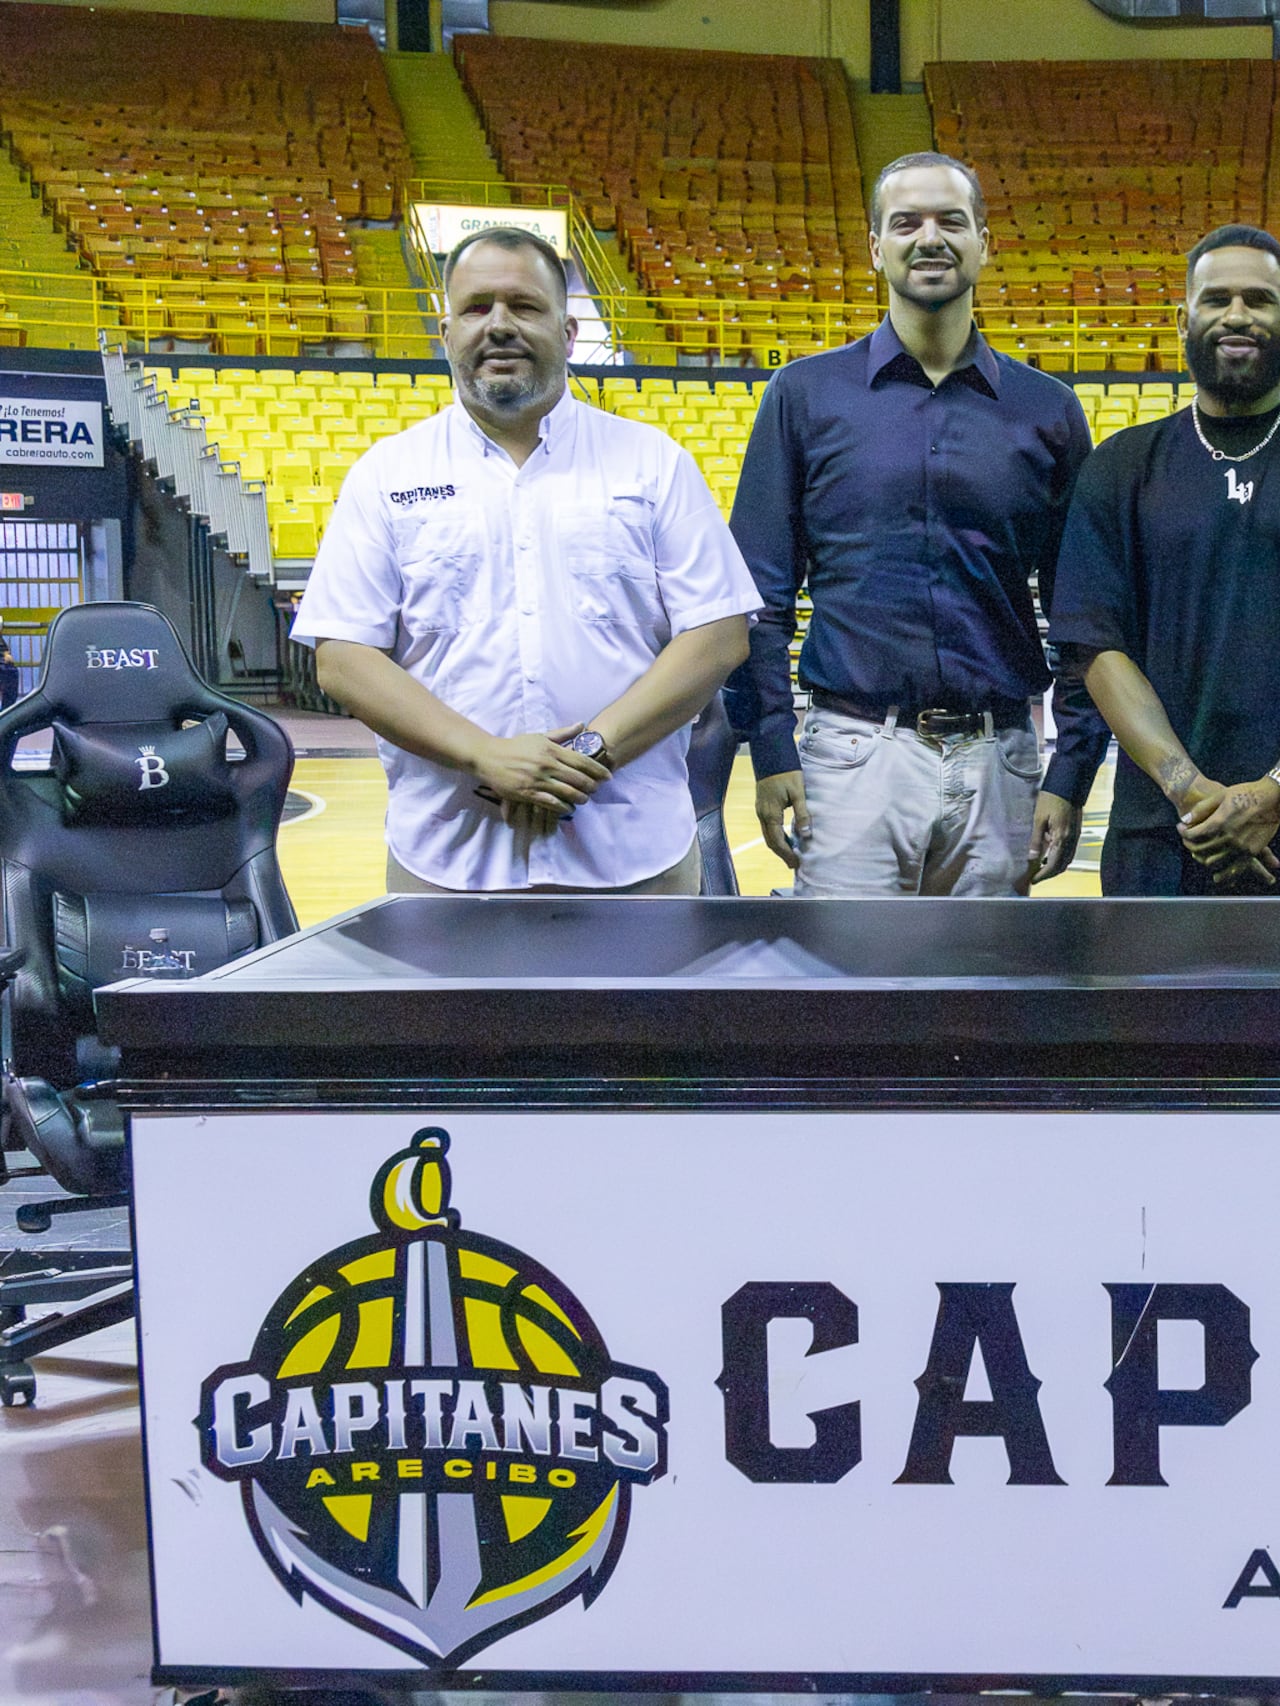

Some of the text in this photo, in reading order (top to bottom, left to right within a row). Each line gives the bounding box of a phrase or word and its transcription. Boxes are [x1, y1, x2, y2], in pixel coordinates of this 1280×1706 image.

[768, 350, 781, 366] B
[21, 405, 65, 417] Tenemos!
[6, 447, 94, 460] cabreraauto.com
[390, 485, 456, 503] CAPITANES
[85, 648, 160, 671] BEAST
[134, 756, 170, 791] B
[209, 1372, 660, 1472] CAPITANES
[305, 1458, 577, 1489] ARECIBO
